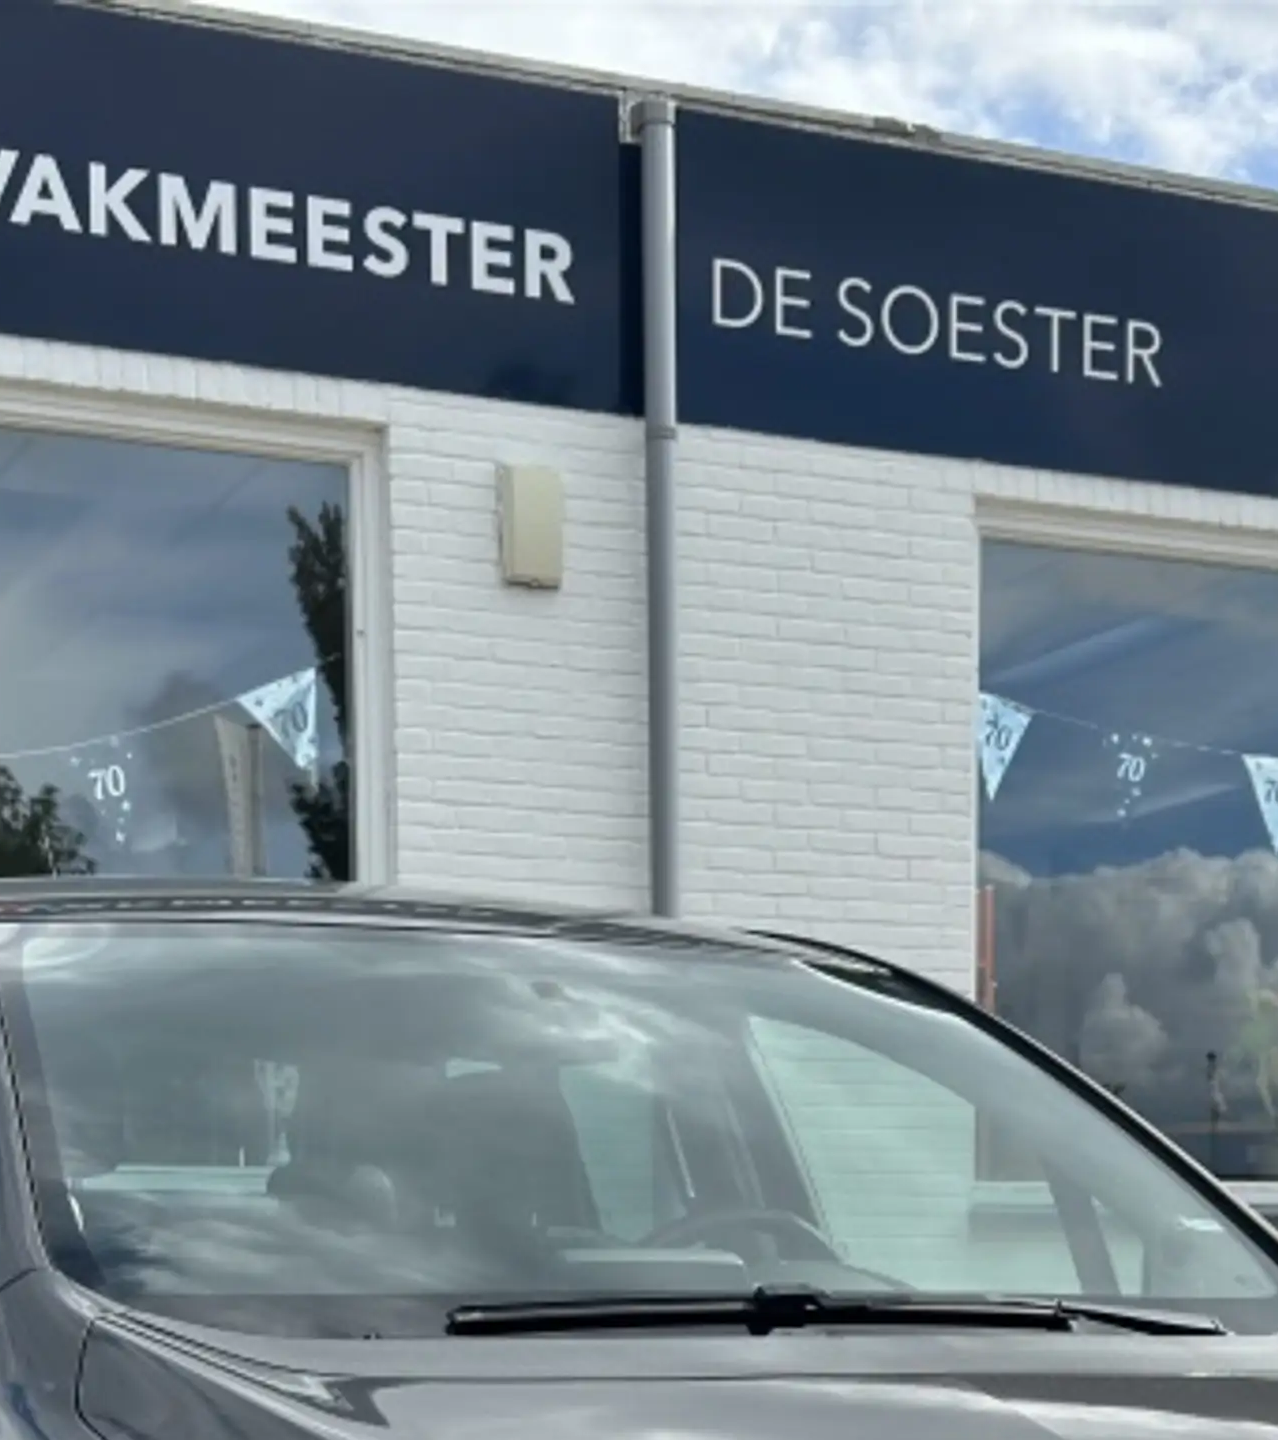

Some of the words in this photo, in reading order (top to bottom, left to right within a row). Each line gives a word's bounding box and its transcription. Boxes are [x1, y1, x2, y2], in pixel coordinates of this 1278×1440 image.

[712, 257, 812, 338] DE
[837, 276, 1163, 388] SOESTER
[983, 721, 1012, 752] 70
[86, 764, 126, 800] 70
[1117, 754, 1145, 782] 70
